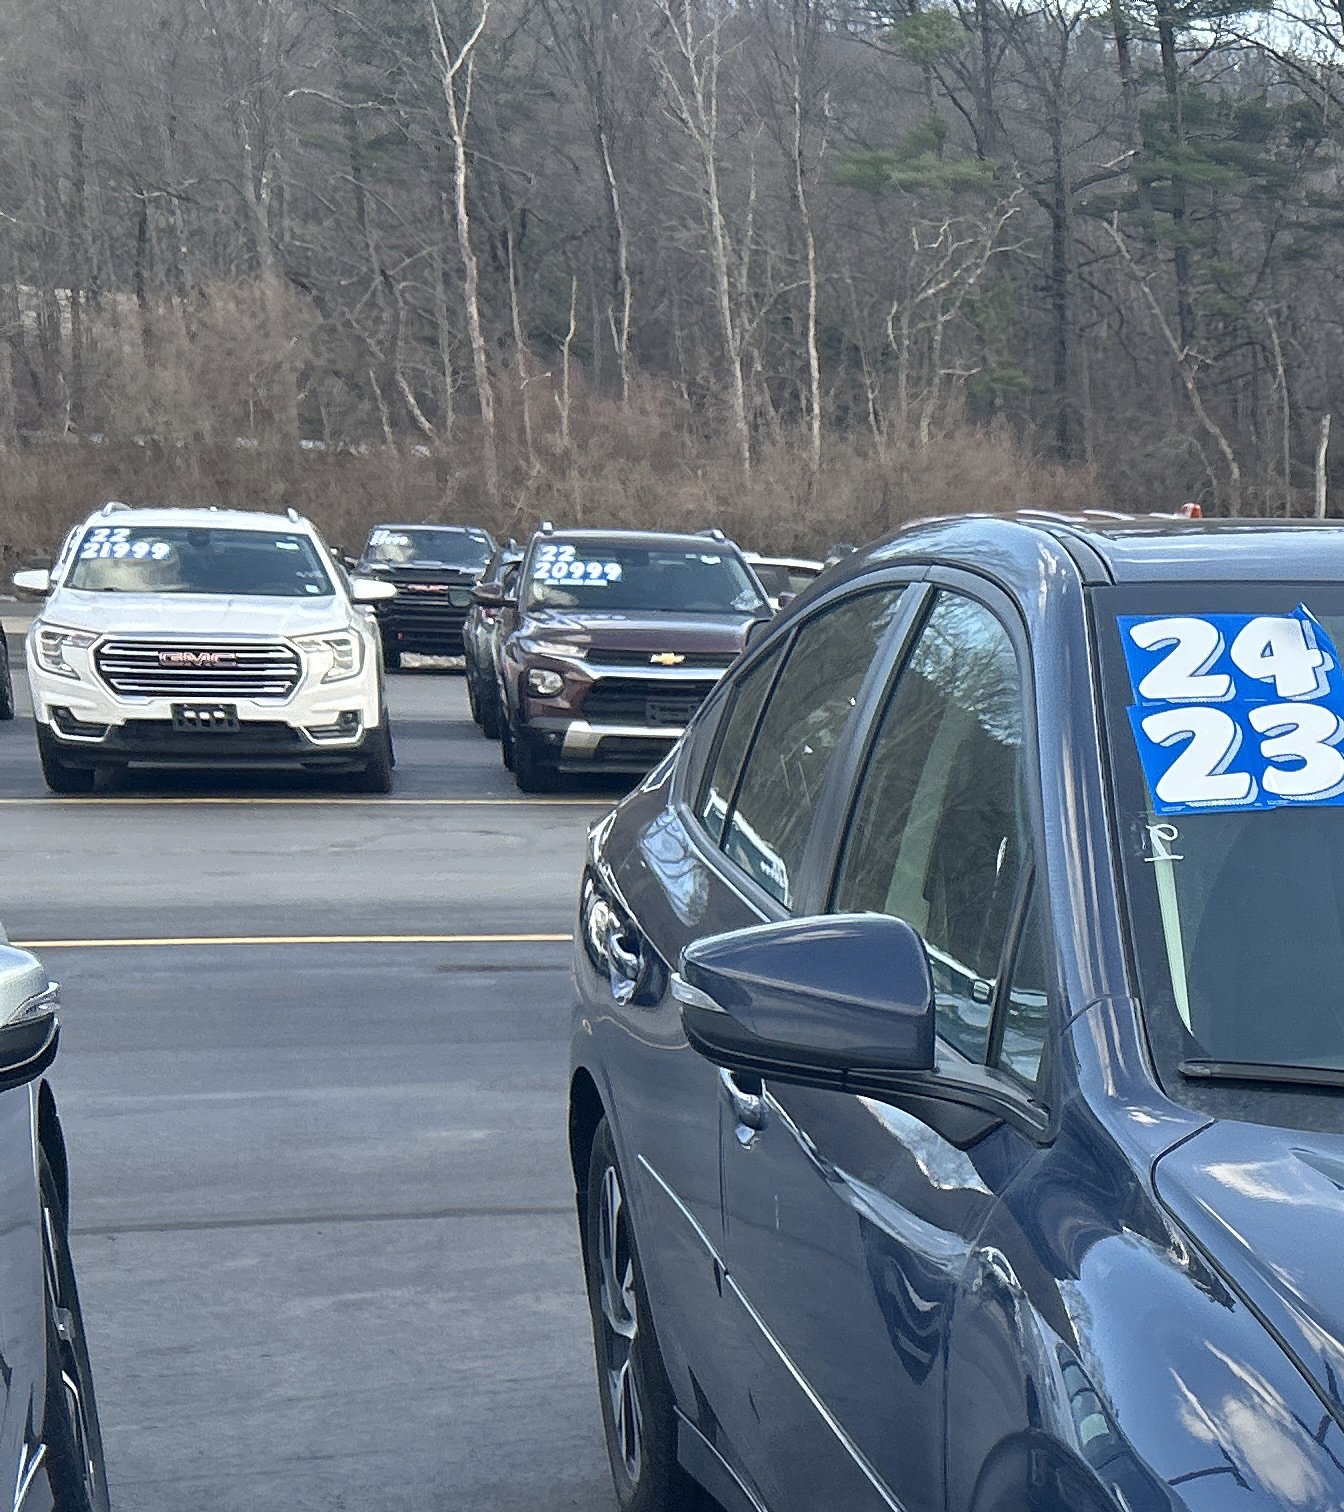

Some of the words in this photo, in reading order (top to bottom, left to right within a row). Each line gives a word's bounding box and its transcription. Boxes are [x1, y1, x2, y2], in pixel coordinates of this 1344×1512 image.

[90, 528, 130, 543] 22
[80, 541, 170, 560] 21999
[539, 546, 576, 562] 22
[533, 562, 622, 581] 20999
[159, 651, 238, 668] GMC
[1129, 616, 1332, 703] 24
